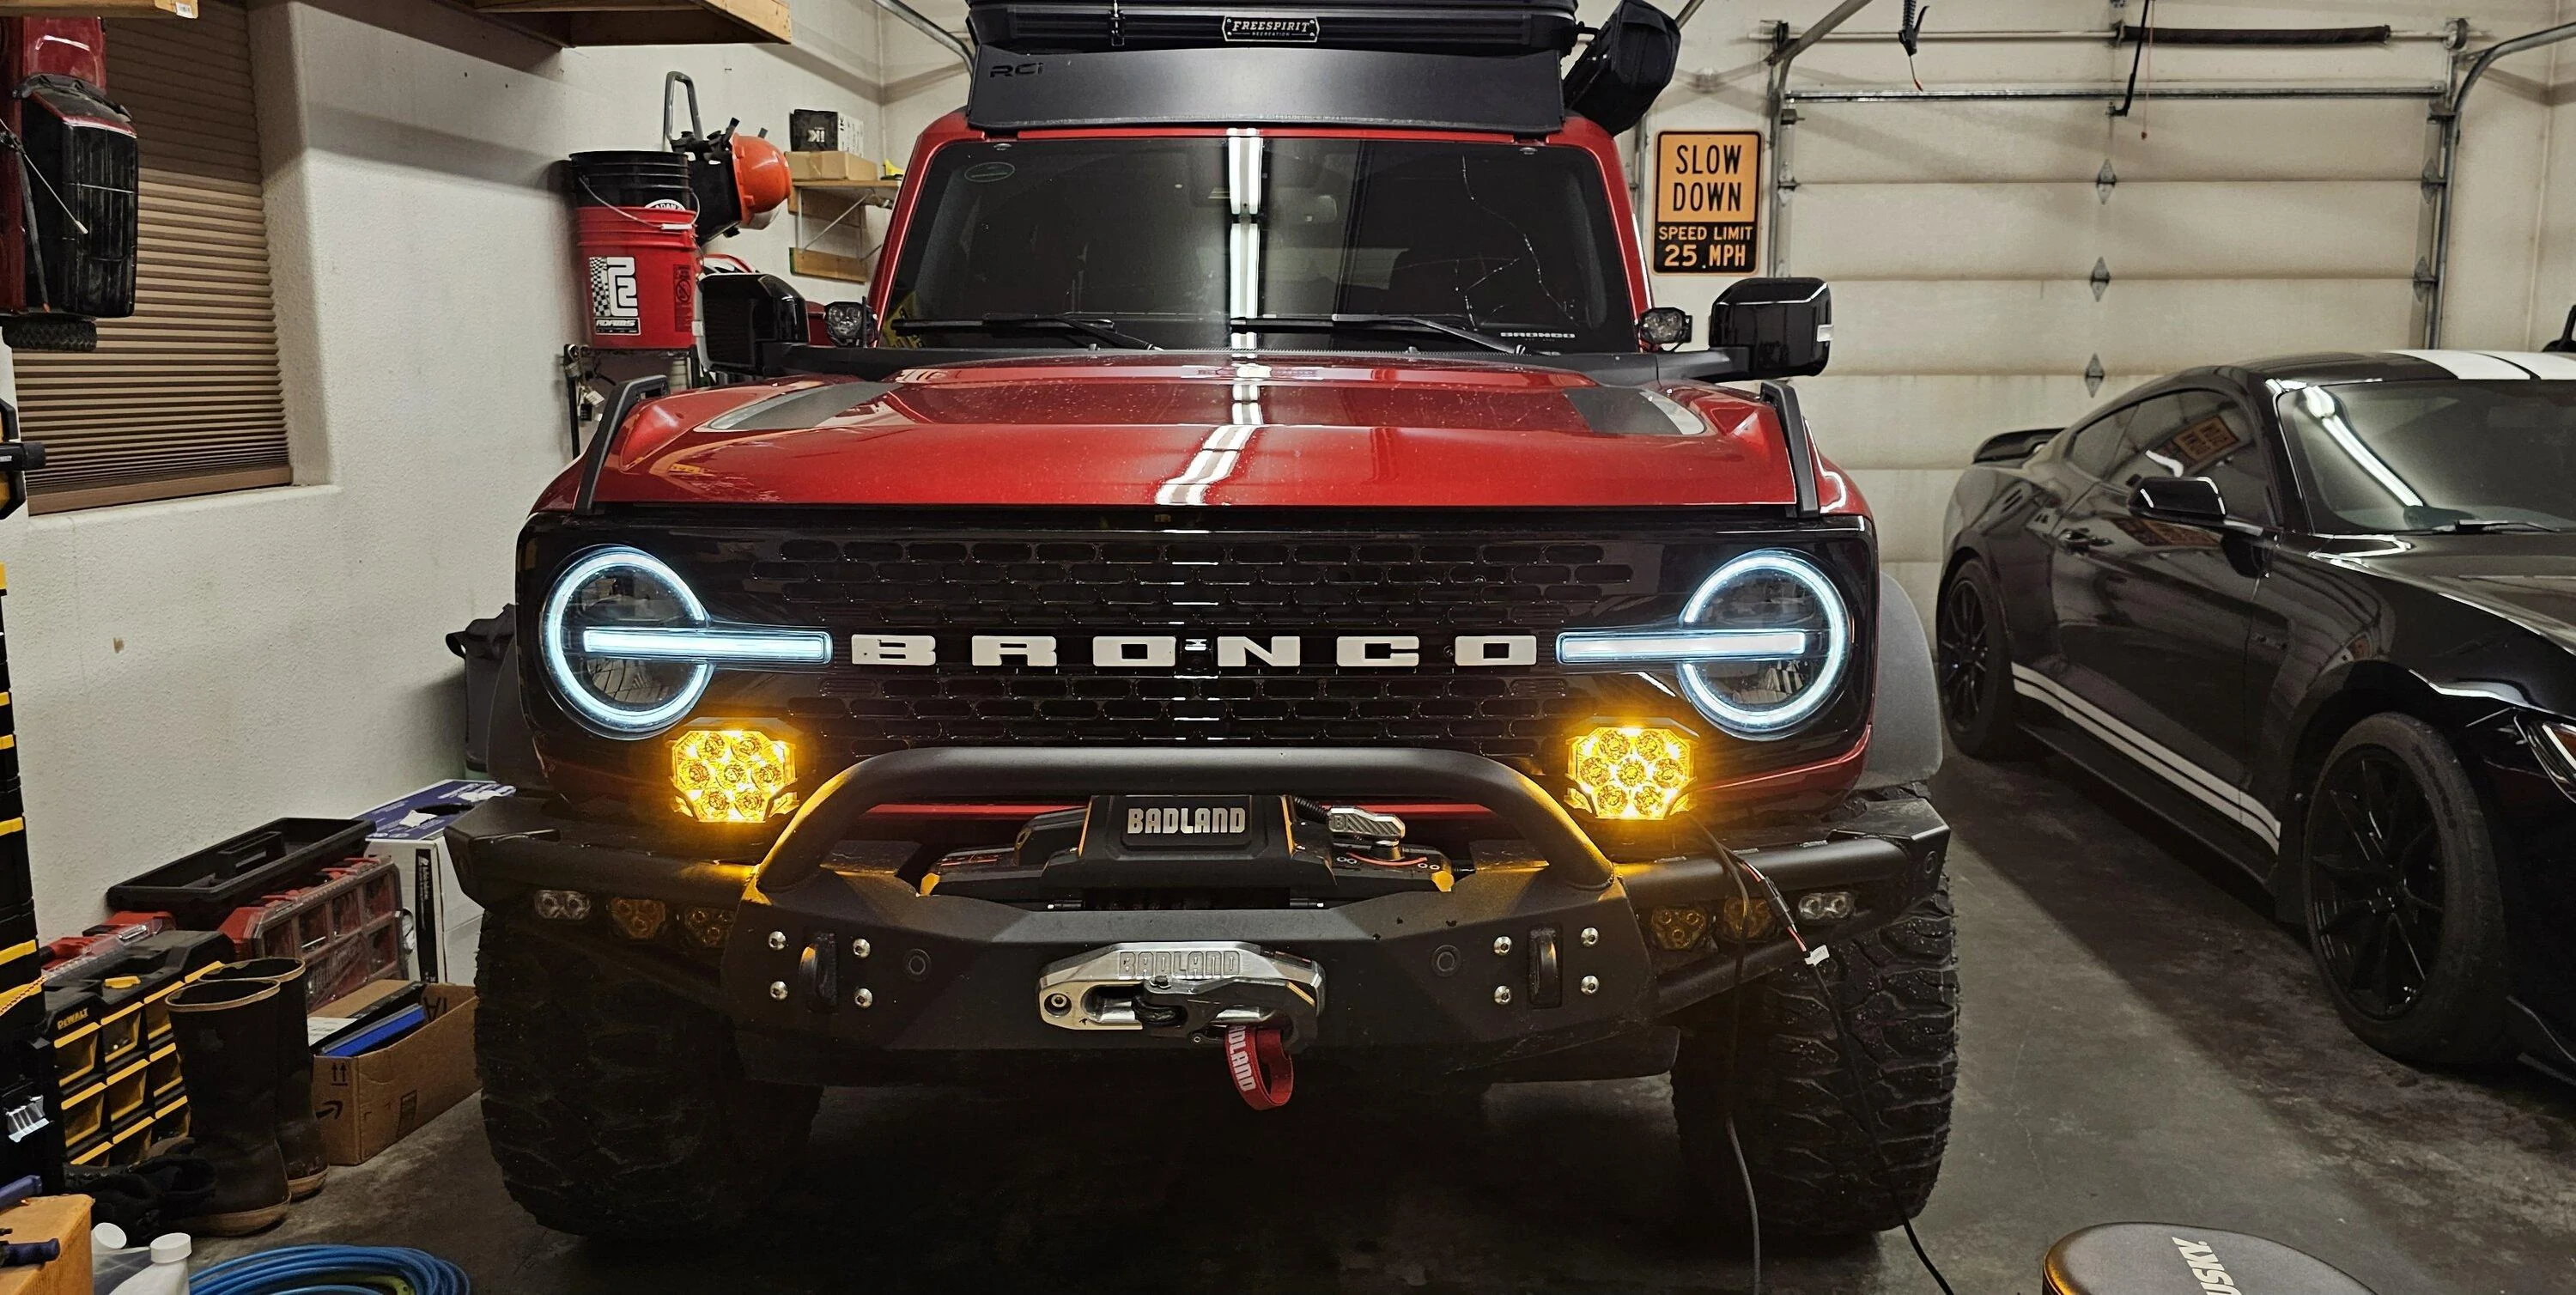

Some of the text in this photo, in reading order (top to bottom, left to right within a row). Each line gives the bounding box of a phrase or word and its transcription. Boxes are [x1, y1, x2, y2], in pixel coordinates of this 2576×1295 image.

[1232, 21, 1310, 33] FREESPIRIT
[1675, 144, 1742, 175] SLOW
[1673, 181, 1742, 212] DOWN
[1658, 226, 1753, 240] SPEED LIMIT
[1664, 244, 1746, 267] 25 MPH
[851, 634, 1538, 667] BRONCO
[1127, 807, 1246, 834] BADLAND
[1118, 951, 1240, 980] BADLAND
[1228, 1025, 1256, 1091] ADLAND
